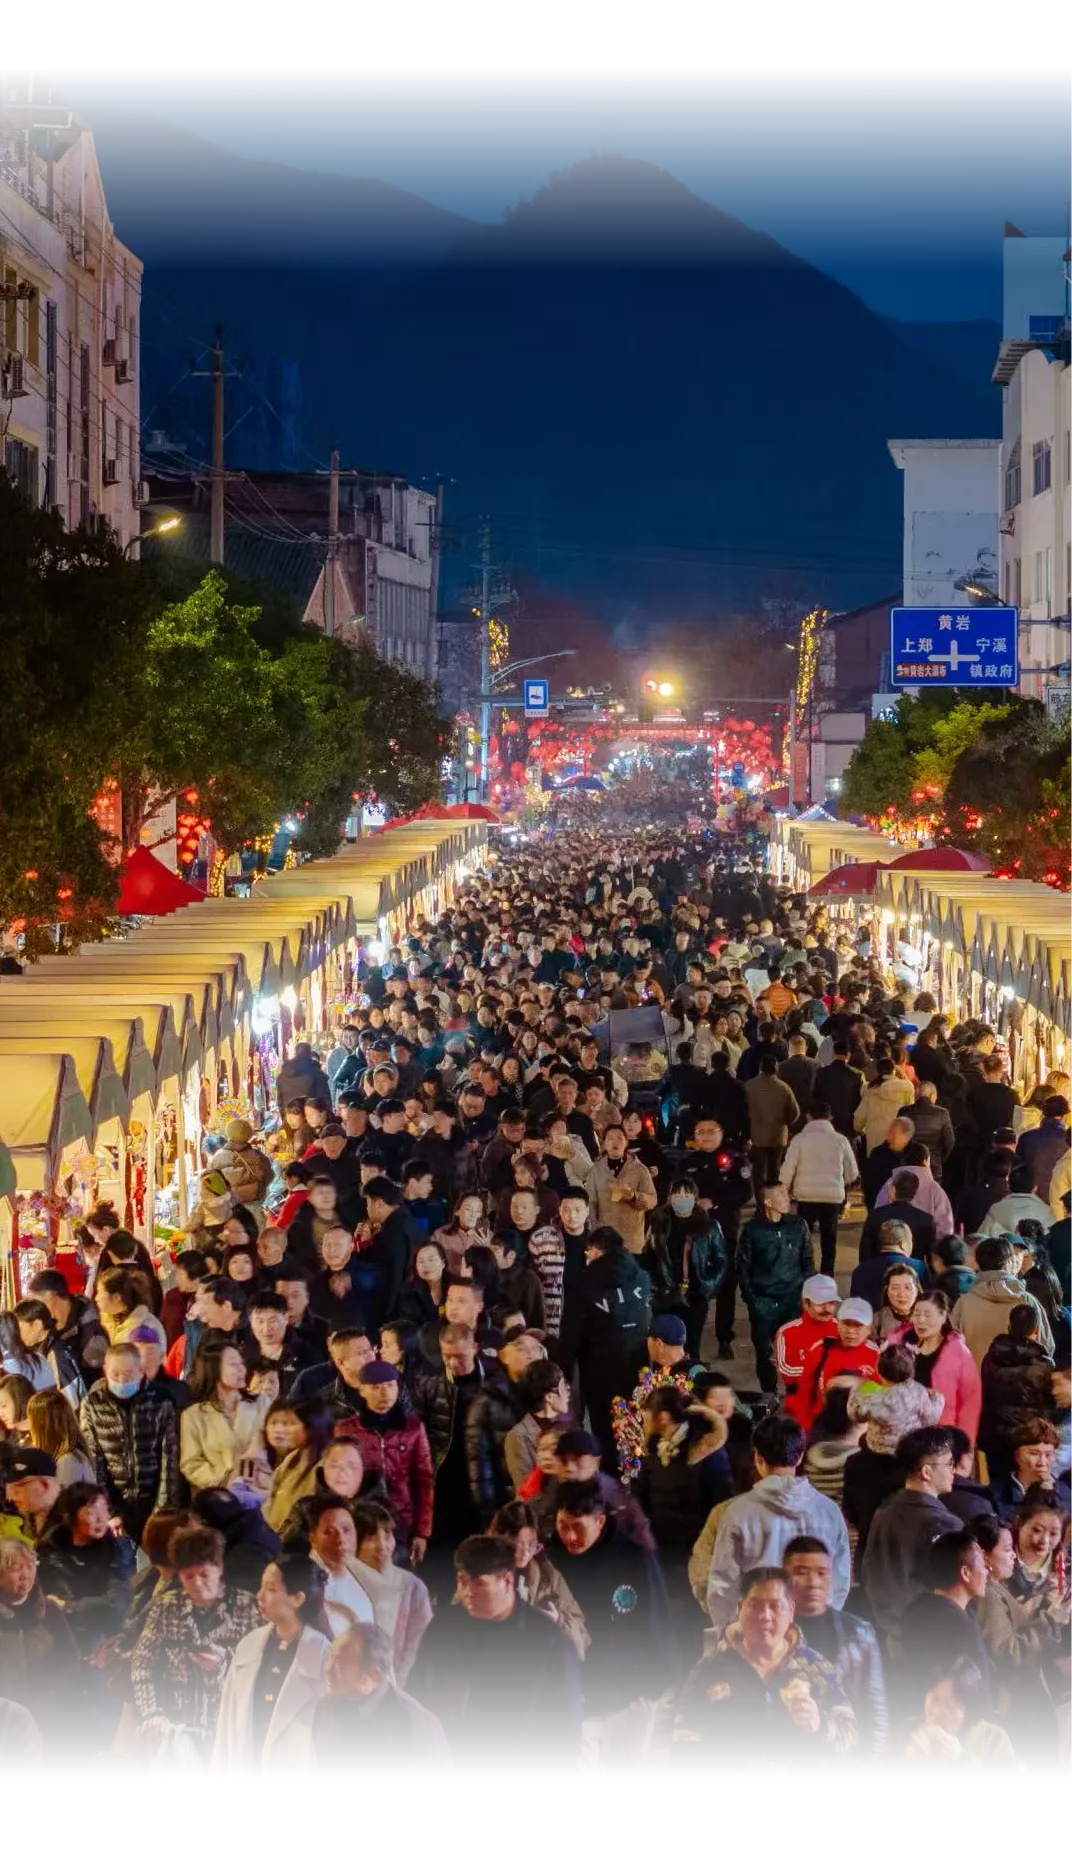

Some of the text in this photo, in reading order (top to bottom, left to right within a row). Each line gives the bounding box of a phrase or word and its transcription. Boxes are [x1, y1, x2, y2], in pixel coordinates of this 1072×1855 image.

[937, 614, 971, 631] 黄岩
[901, 637, 934, 653] 上郑
[976, 637, 1007, 653] 宁溪
[969, 664, 1013, 678] 镇政府
